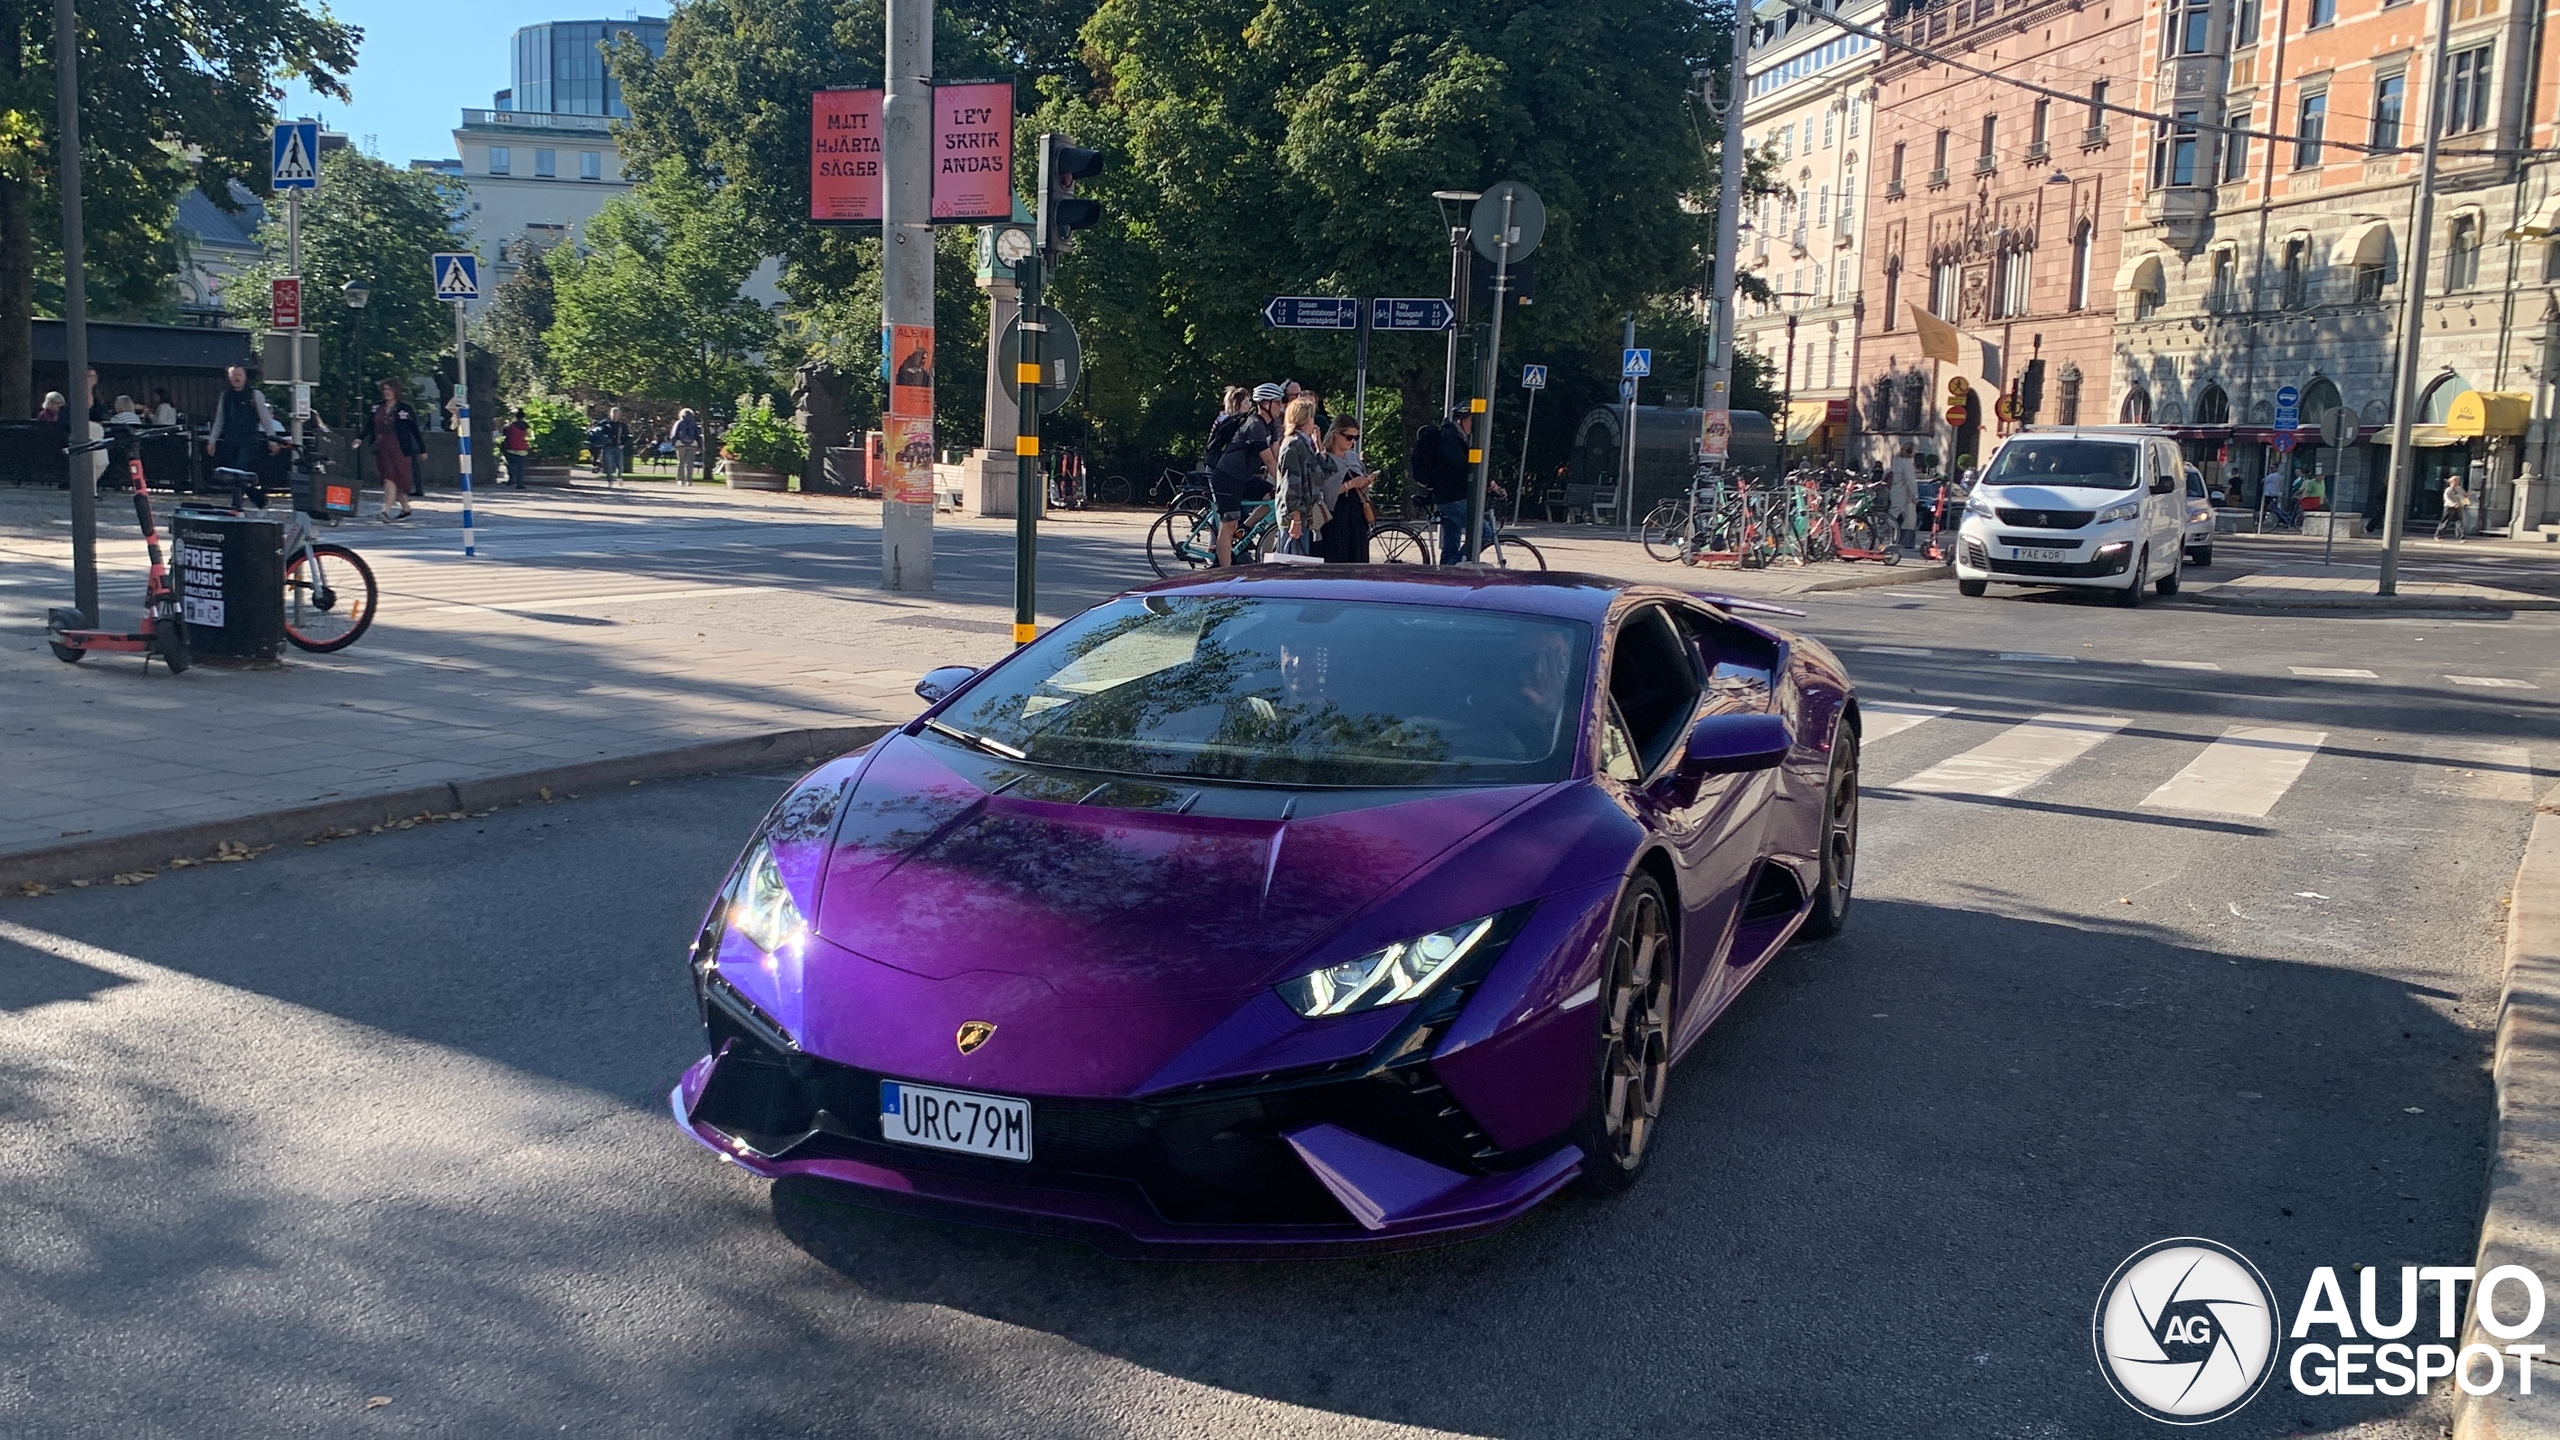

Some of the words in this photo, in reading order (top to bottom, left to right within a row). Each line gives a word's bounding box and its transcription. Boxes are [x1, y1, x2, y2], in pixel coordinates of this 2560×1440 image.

[953, 108, 991, 125] LEV
[815, 135, 881, 153] HJÄRTA
[944, 132, 1000, 149] SKRIK
[819, 159, 878, 176] SÄGER
[942, 156, 1003, 174] ANDAS
[1297, 309, 1337, 318] Centralstationen
[1396, 302, 1410, 310] Täby
[1297, 317, 1338, 325] Kungsträdgården
[1395, 319, 1419, 327] Stureplan
[184, 548, 223, 570] FREE
[2021, 549, 2039, 559] YAE
[184, 569, 223, 587] MUSIC
[184, 585, 223, 599] PROJECTS
[903, 1093, 1024, 1152] URC79M
